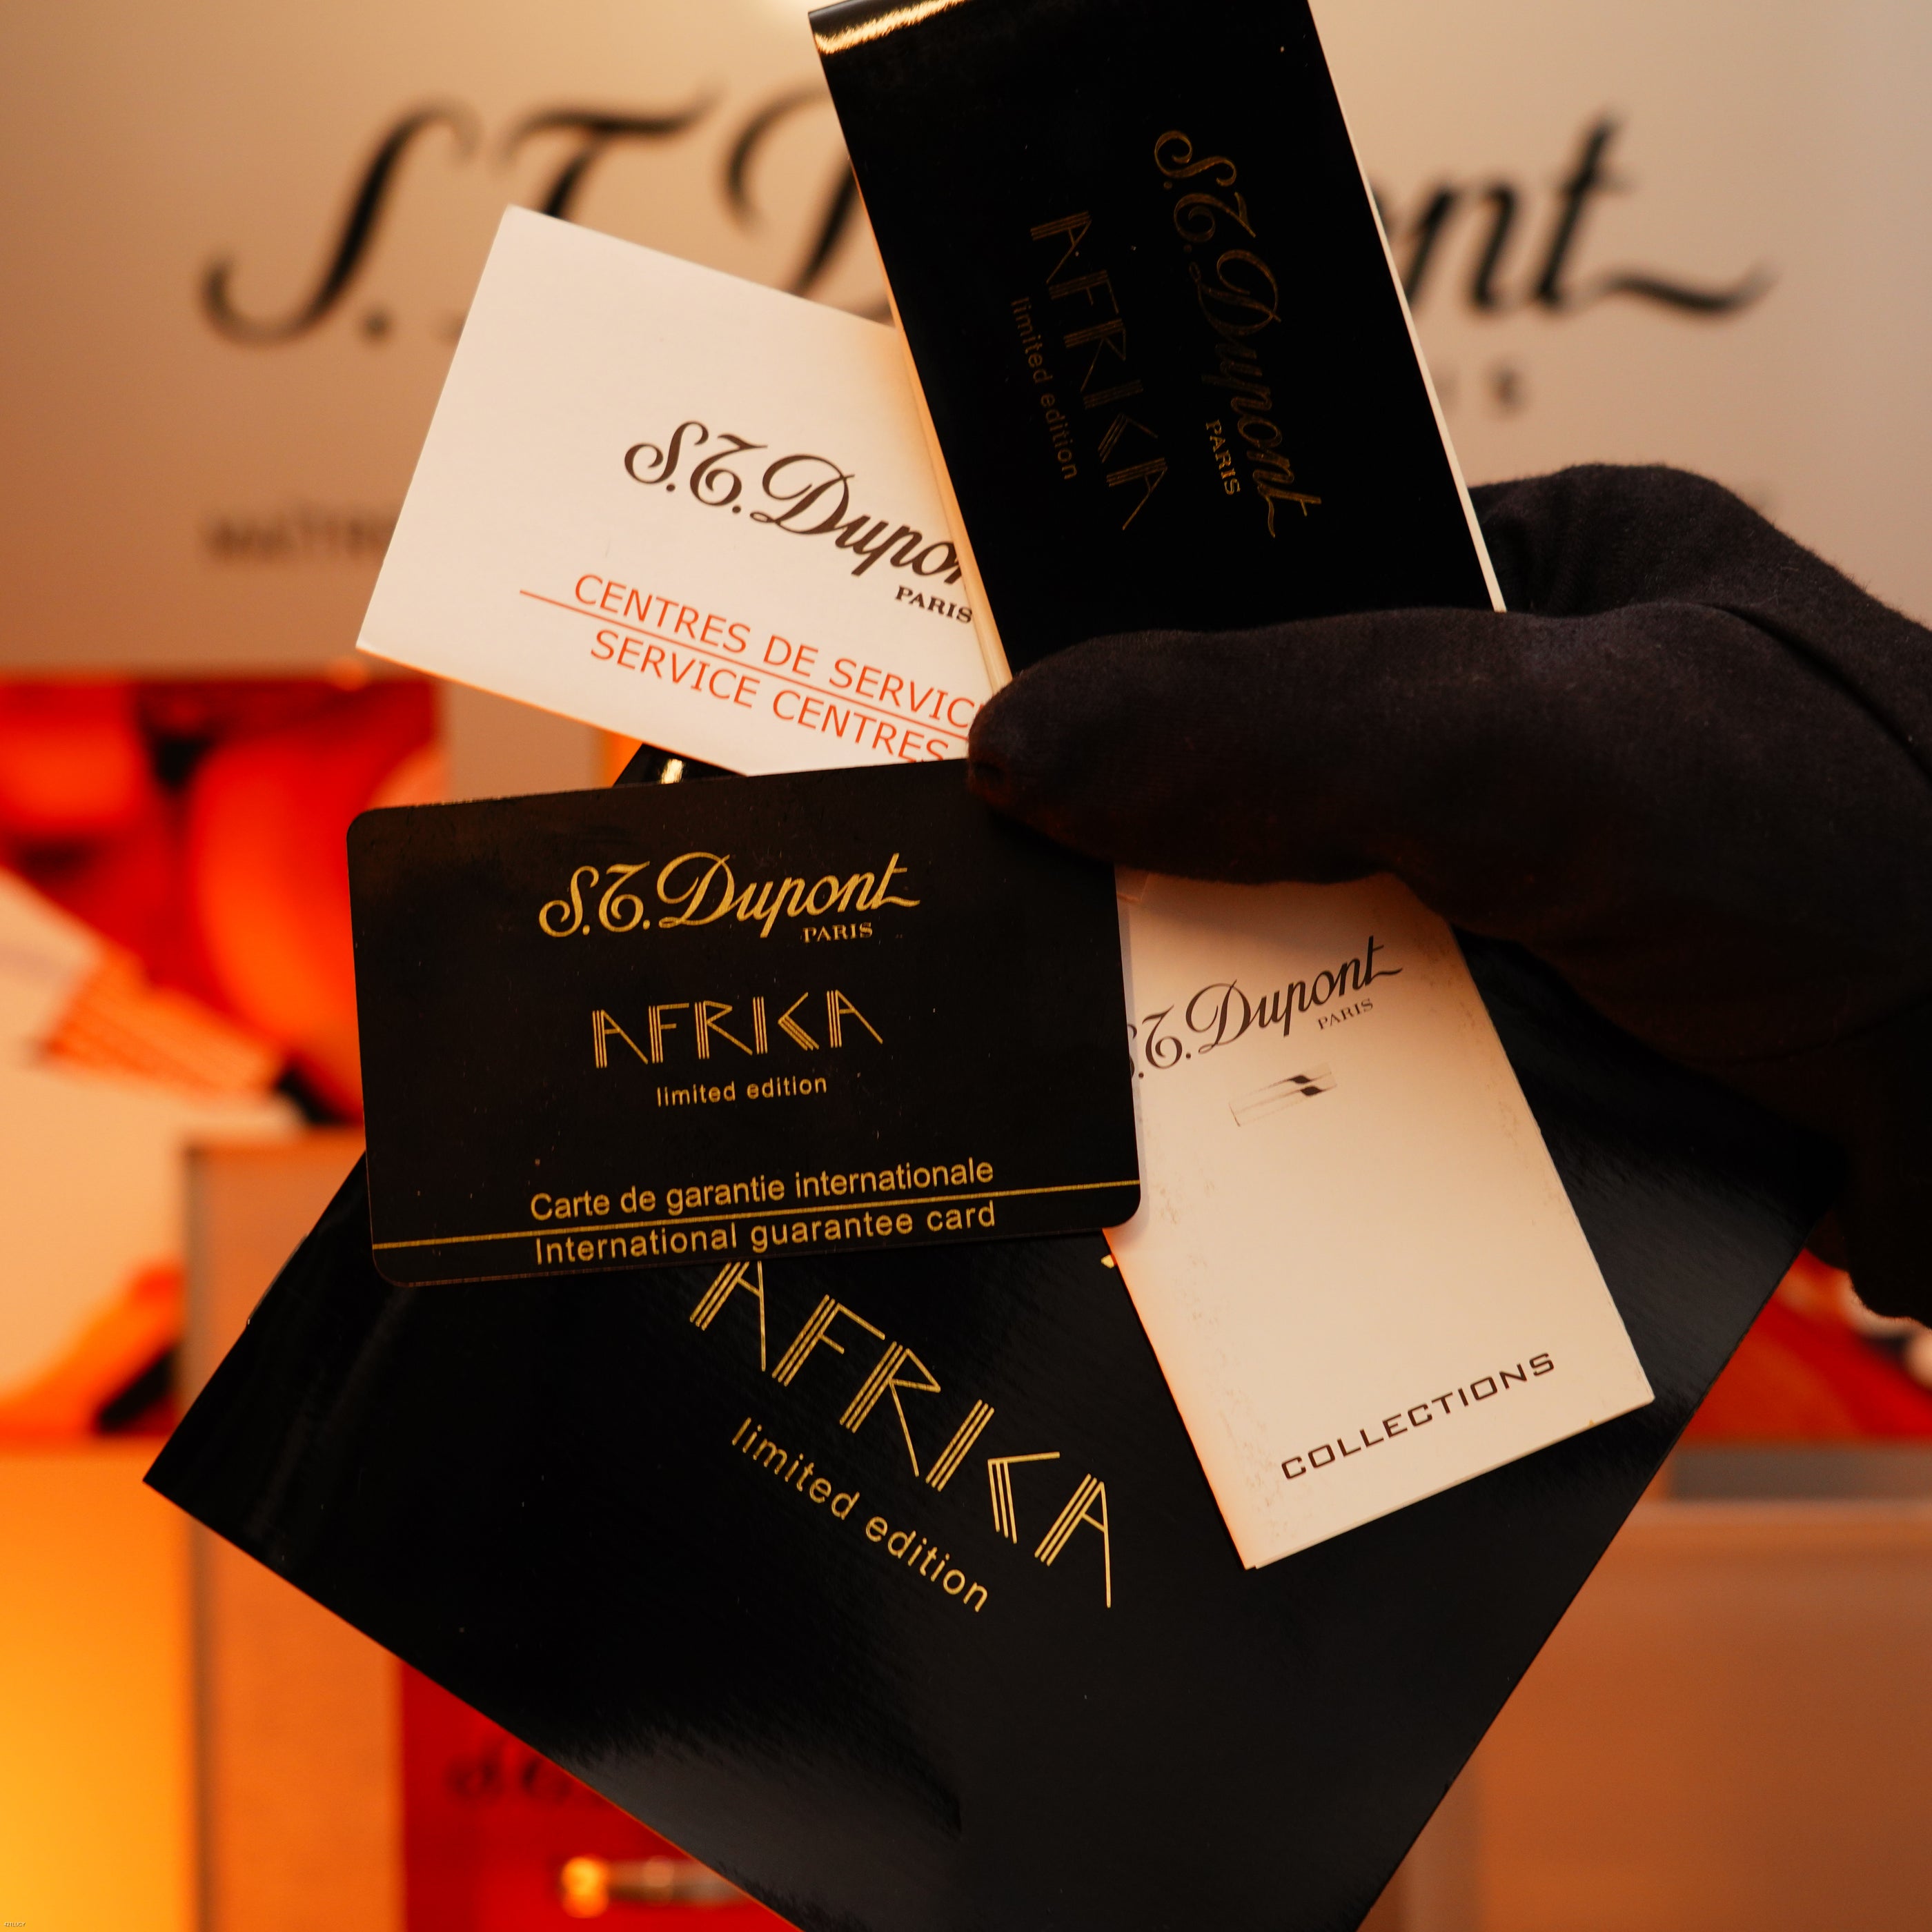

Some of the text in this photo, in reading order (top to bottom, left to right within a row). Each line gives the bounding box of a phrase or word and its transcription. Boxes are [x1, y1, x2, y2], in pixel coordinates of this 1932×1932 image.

[1011, 296, 1078, 480] limited edition
[1030, 210, 1168, 531] AFRIKA
[1188, 248, 1322, 539] Dupont
[1205, 418, 1241, 496] PARIS
[895, 584, 973, 624] PARIS
[574, 573, 985, 729] CENTRES DE SERVIC
[590, 629, 760, 709] SERVICE
[657, 851, 921, 939] Dupont
[802, 921, 874, 943] PARIS
[591, 989, 884, 1069] AFRIKA
[1198, 935, 1403, 1054] Dupont
[1317, 998, 1374, 1031] PARIS
[656, 1074, 828, 1107] limited edition
[530, 1156, 994, 1221] Carte de garantie internationale
[535, 1199, 996, 1265] International guarantee card
[689, 1260, 1112, 1608] AFRIKA
[1281, 1352, 1555, 1480] COLLECTIONS
[731, 1417, 989, 1613] limited edition
